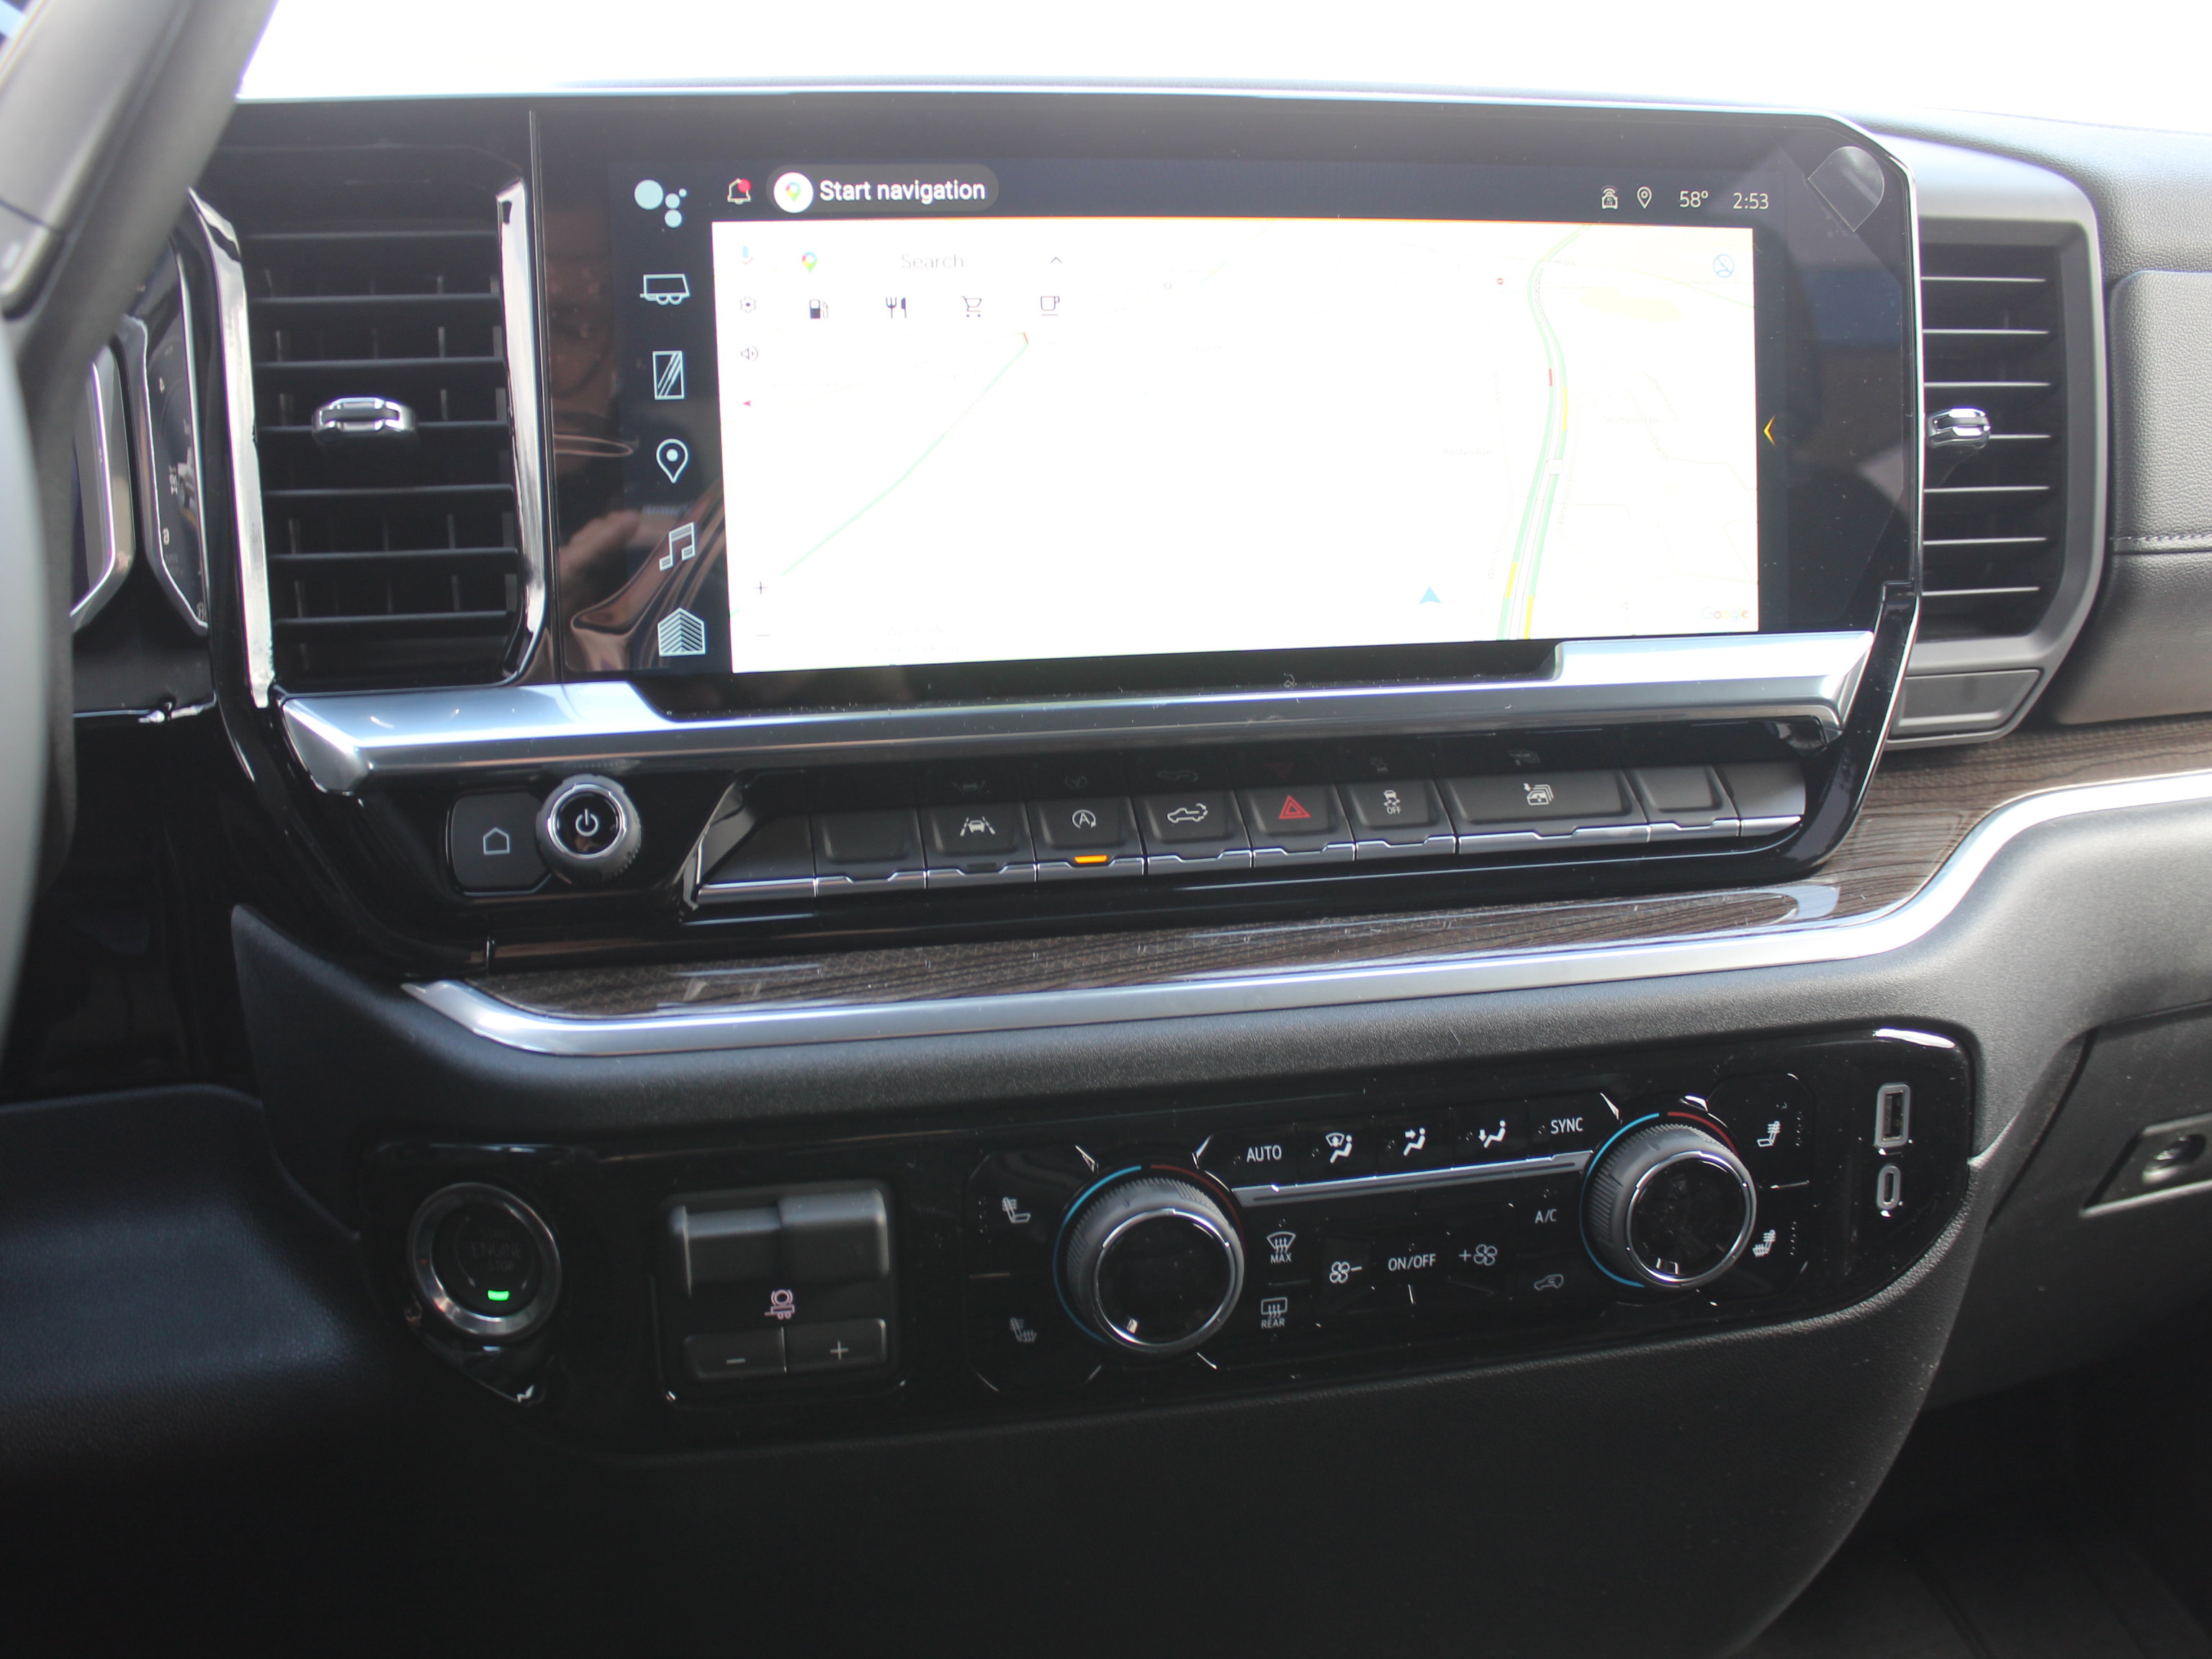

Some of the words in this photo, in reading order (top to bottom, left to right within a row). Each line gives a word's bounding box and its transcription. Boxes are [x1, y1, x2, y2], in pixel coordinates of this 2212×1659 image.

[819, 179, 871, 201] Start
[877, 179, 986, 205] navigation
[1732, 192, 1770, 210] 2:53
[901, 253, 965, 269] Search
[1701, 606, 1749, 623] Google
[1079, 811, 1091, 826] A
[1386, 806, 1402, 815] OFF
[1550, 1117, 1583, 1135] SYNC
[1246, 1144, 1282, 1163] AUTO
[1534, 1208, 1557, 1224] A/C
[471, 1241, 521, 1259] ENGINE
[1270, 1252, 1292, 1264] MAX
[1388, 1253, 1437, 1272] ON/OFF
[1261, 1317, 1286, 1329] REAR
